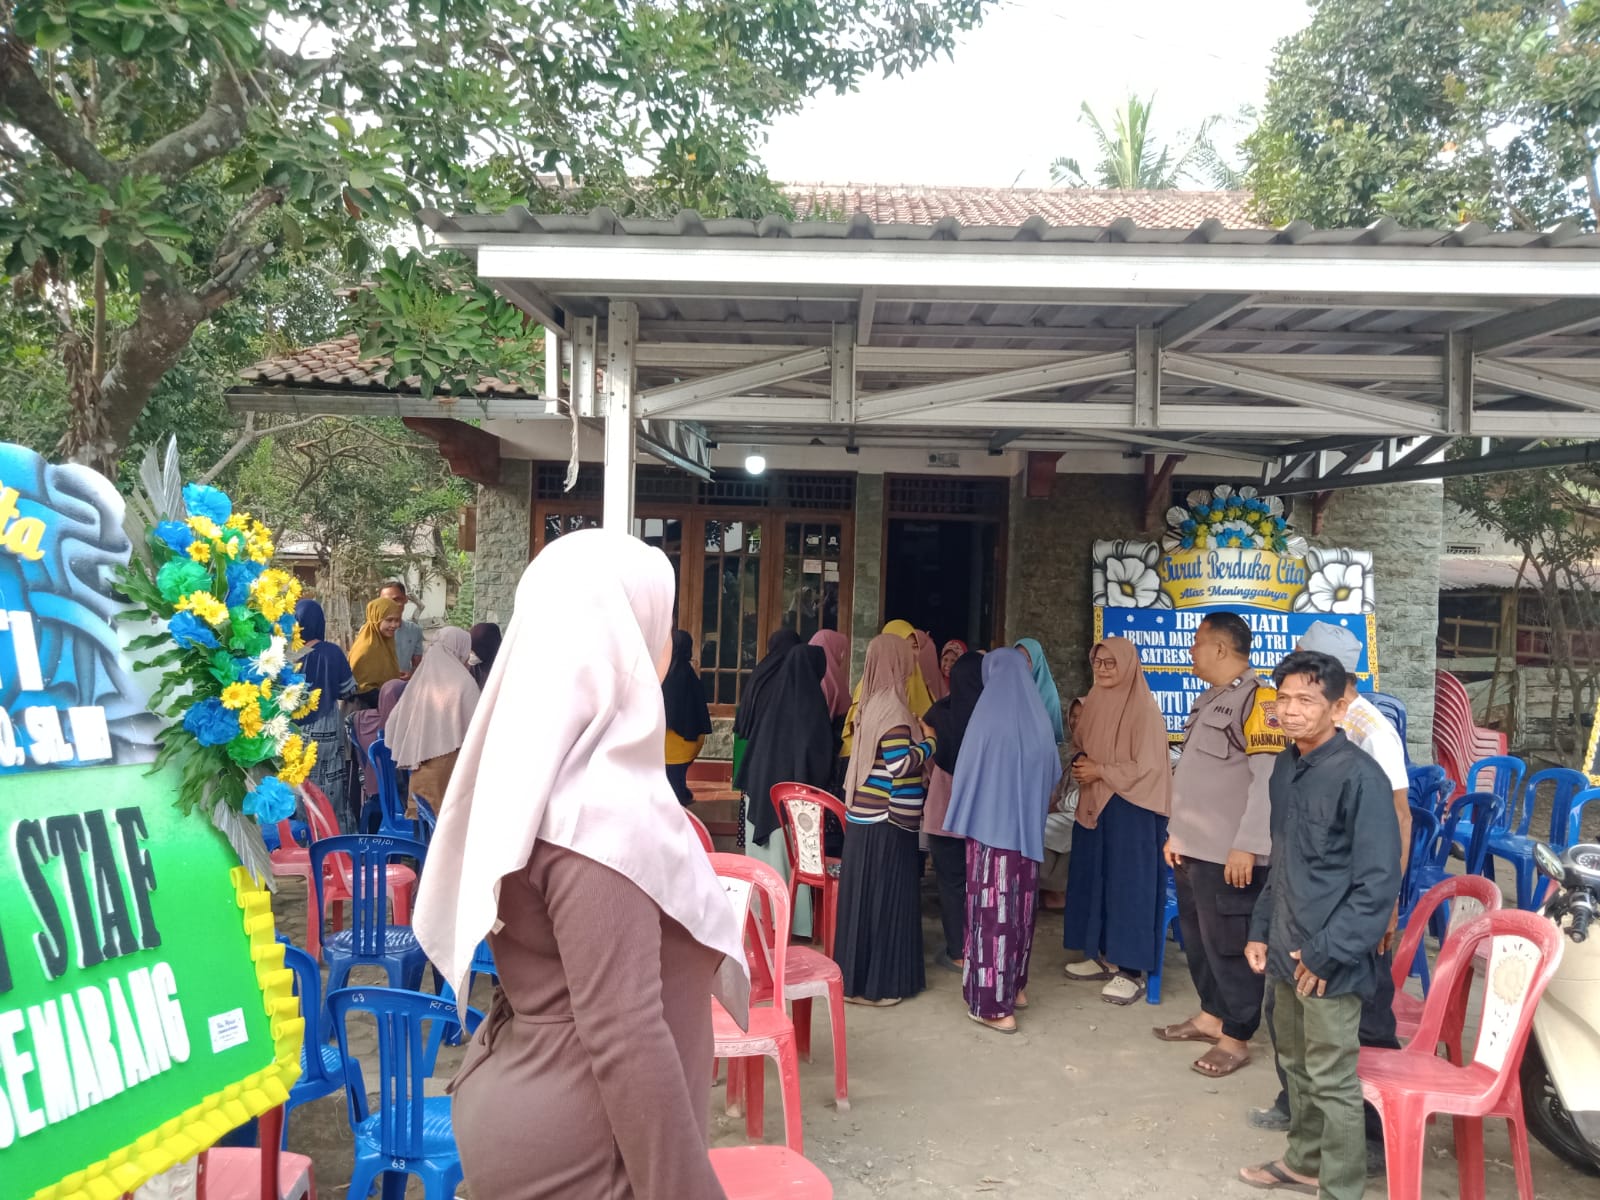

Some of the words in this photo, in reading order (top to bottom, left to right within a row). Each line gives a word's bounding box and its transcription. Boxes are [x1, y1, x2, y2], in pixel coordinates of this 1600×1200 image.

[1162, 556, 1203, 582] Turut
[1207, 550, 1271, 582] Berduka
[1277, 557, 1305, 585] Cita
[1179, 587, 1205, 599] Atas
[1208, 585, 1289, 602] Meninggalnya
[1123, 630, 1166, 647] IBUNDA
[1265, 634, 1287, 650] TRI
[1182, 677, 1213, 690] KAPO
[10, 806, 162, 982] STAF
[429, 1000, 441, 1010] RT
[391, 1158, 406, 1170] 63
